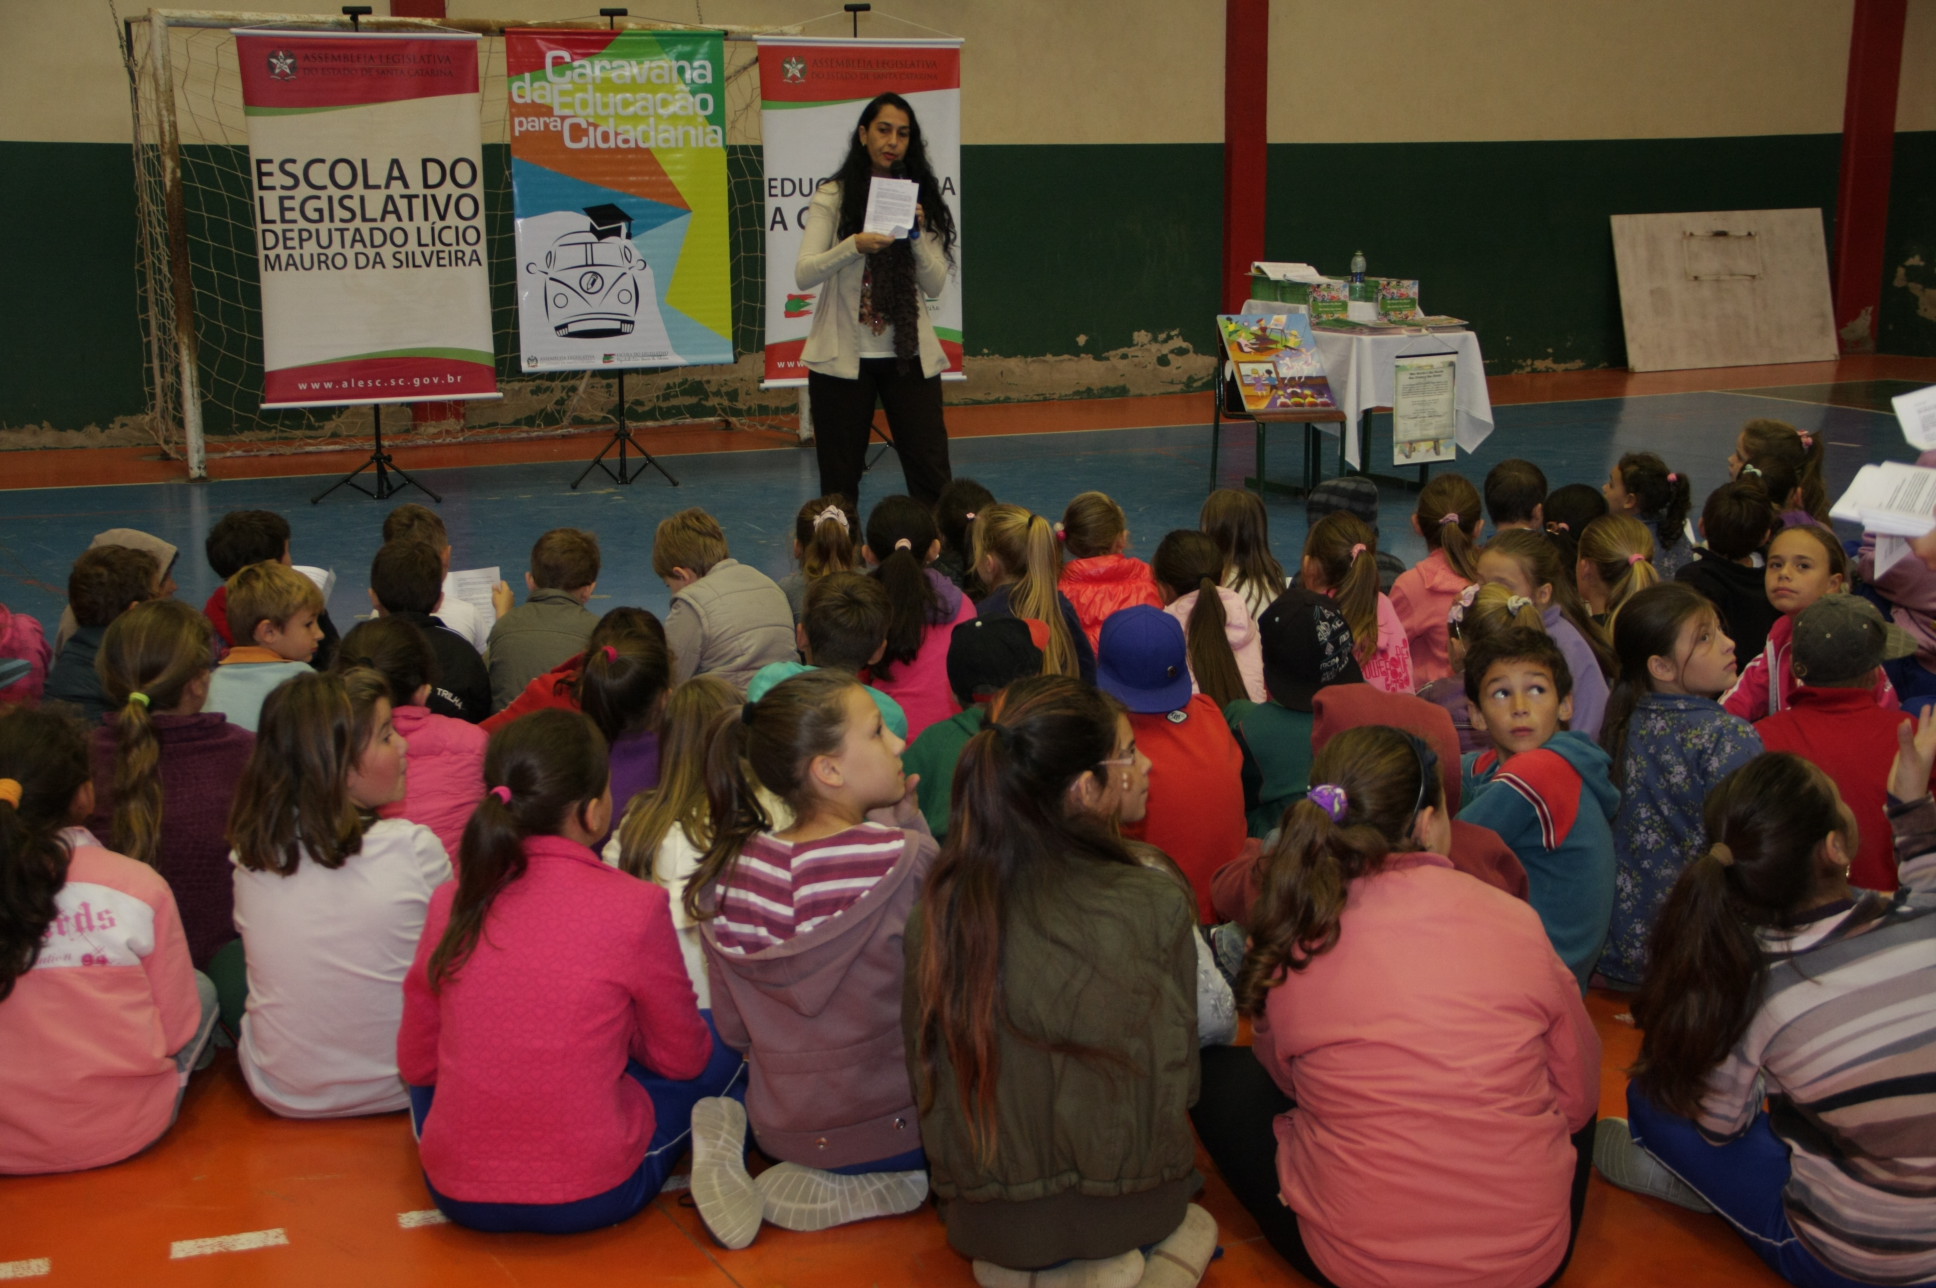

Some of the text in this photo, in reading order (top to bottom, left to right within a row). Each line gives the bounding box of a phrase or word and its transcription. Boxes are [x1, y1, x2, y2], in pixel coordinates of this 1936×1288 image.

[545, 50, 712, 84] Caravana
[511, 72, 714, 119] da Educação
[514, 116, 723, 148] para Cidadania
[255, 157, 478, 191] ESCOLA DO
[258, 193, 480, 224] LEGISLATIVO
[261, 221, 481, 250] DEPUTADO LÍCIO
[264, 249, 483, 272] MAURO DA SILVEIRA
[298, 374, 462, 390] www.alesc.sc.gov.br
